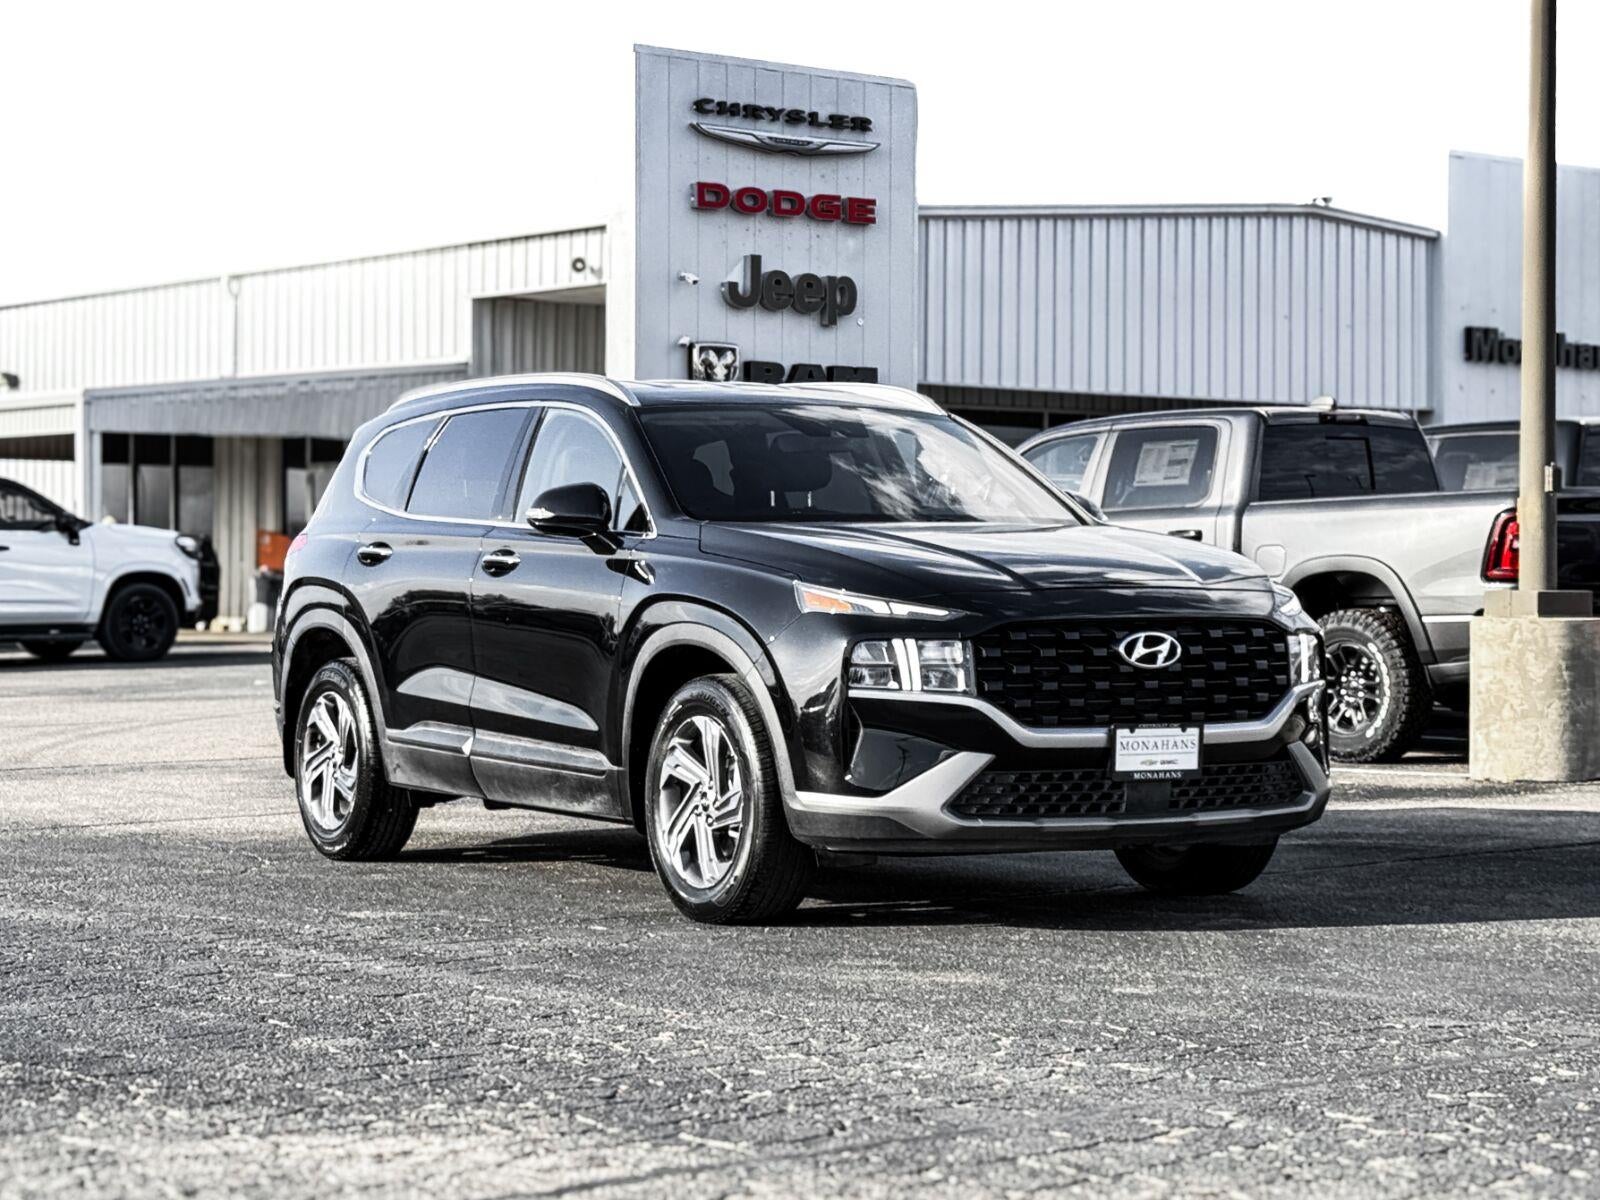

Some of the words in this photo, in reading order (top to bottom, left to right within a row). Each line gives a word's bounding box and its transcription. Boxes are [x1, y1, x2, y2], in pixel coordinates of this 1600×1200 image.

[692, 98, 873, 132] CHRYSLER
[691, 181, 877, 224] DODGE
[721, 254, 858, 326] Jeep
[1464, 326, 1600, 370] Moha
[1120, 739, 1196, 752] MONAHANS
[1133, 771, 1182, 780] MONAHANS
